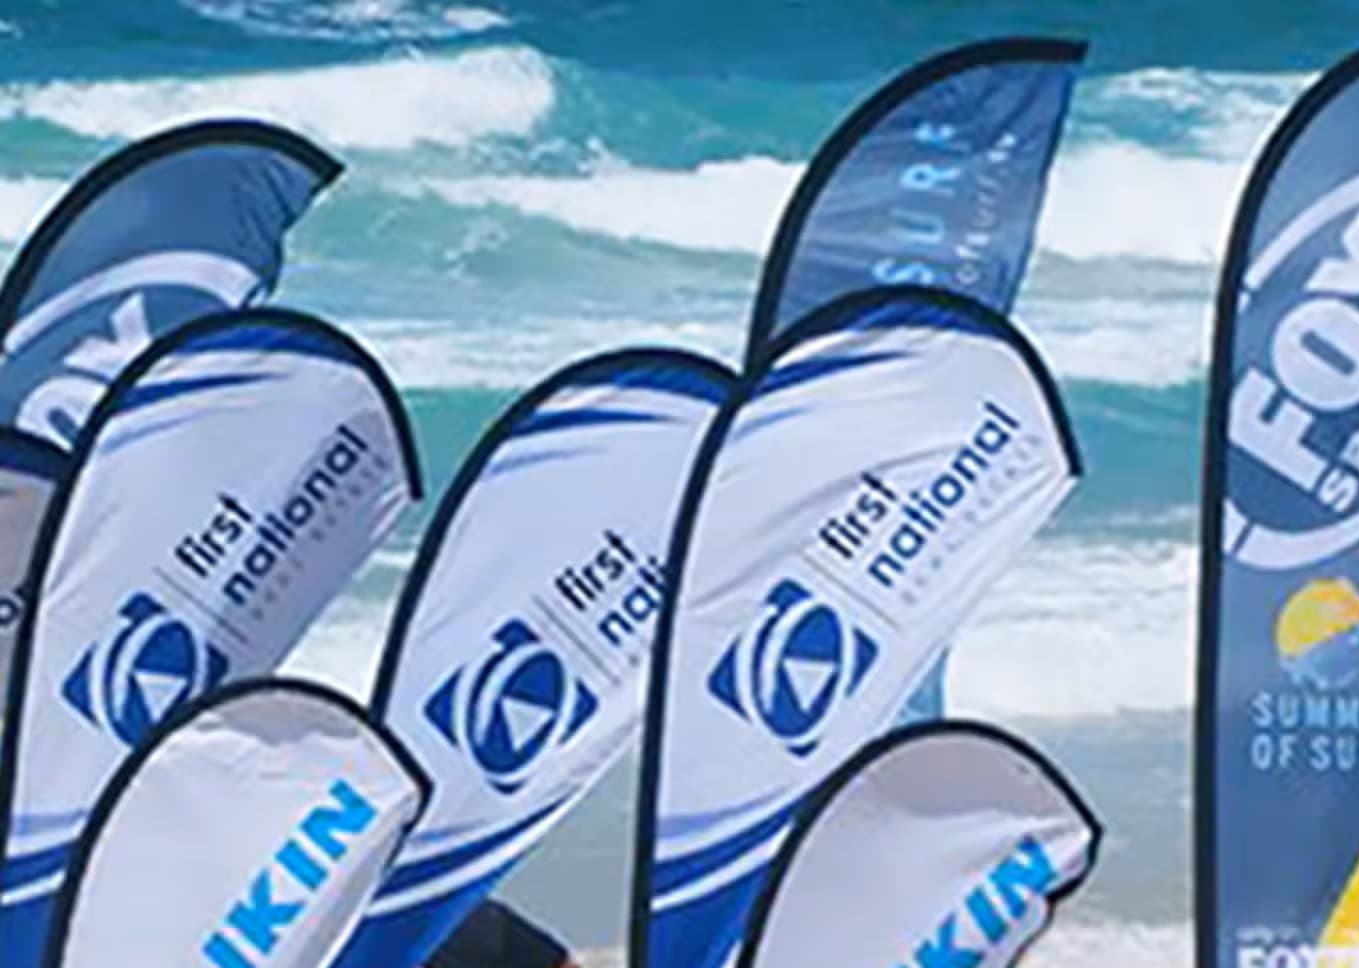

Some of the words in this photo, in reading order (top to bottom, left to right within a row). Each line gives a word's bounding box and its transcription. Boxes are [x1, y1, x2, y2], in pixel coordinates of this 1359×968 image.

[174, 493, 255, 577] first
[223, 424, 369, 606] national
[818, 472, 898, 560] first
[868, 402, 1020, 588] national
[554, 529, 637, 611] first
[1251, 733, 1300, 770] OF
